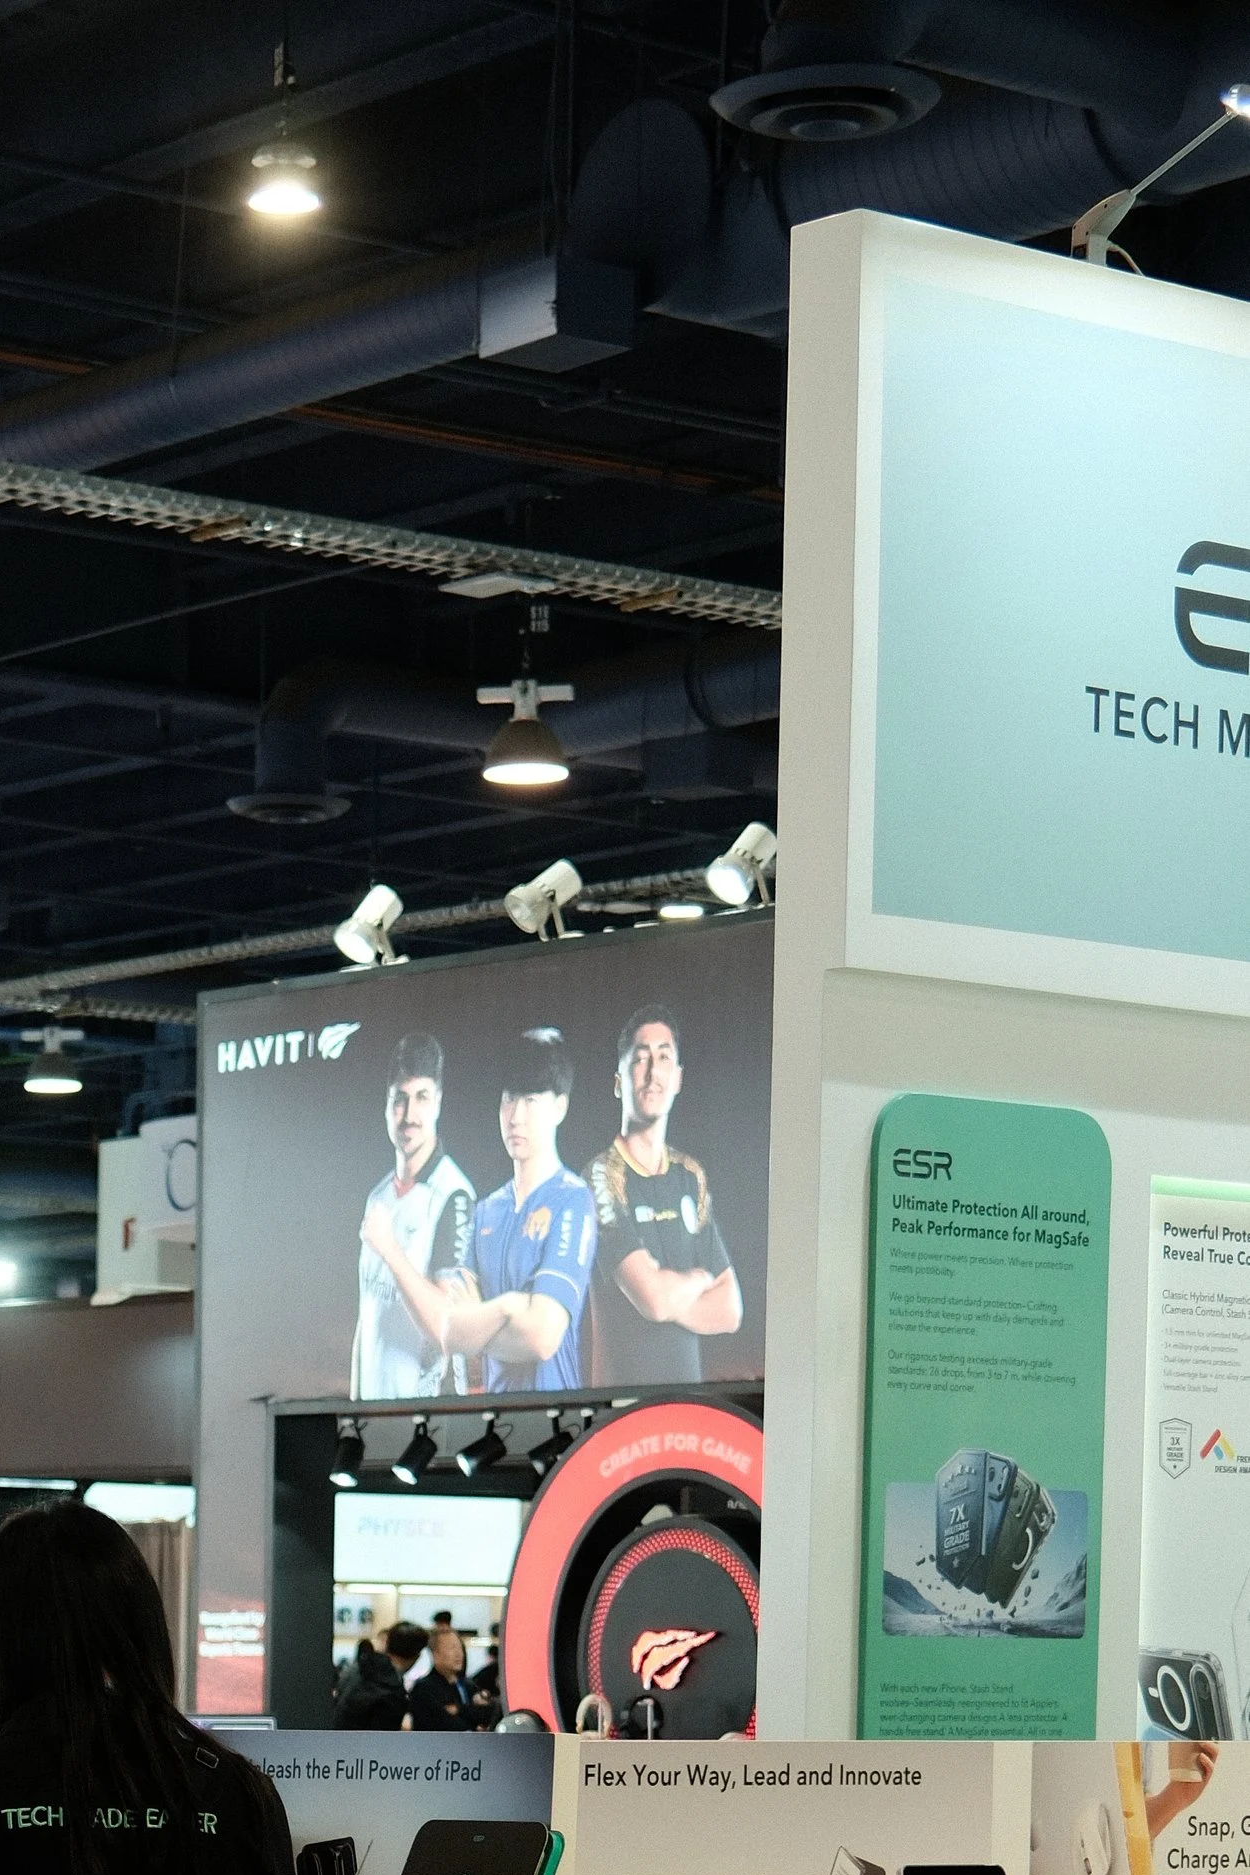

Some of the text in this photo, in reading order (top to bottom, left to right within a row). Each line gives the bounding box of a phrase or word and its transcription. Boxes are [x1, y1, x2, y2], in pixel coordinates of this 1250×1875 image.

[1085, 685, 1199, 750] TECH
[217, 1030, 305, 1074] HAVIT
[892, 1148, 953, 1180] ESR
[892, 1194, 1090, 1226] Ultimate Protection All around,
[892, 1217, 1090, 1249] Peak Performance for MagSafe
[1163, 1222, 1218, 1240] Powerful
[890, 1248, 916, 1259] Where
[918, 1251, 943, 1263] power
[944, 1254, 968, 1264] meets
[1008, 1256, 1033, 1268] Where
[1035, 1259, 1074, 1271] protection
[1163, 1245, 1204, 1262] Reveal
[1207, 1248, 1234, 1264] True
[890, 1264, 913, 1274] meets
[917, 1293, 946, 1306] beyond
[949, 1296, 982, 1307] standard
[1162, 1289, 1188, 1301] Classic
[1190, 1291, 1215, 1304] Hybrid
[889, 1308, 1064, 1327] solutions that keep up with daily demands and
[1161, 1303, 1193, 1315] (Camera
[1195, 1306, 1224, 1319] Control,
[1226, 1308, 1246, 1319] Stash
[888, 1322, 916, 1332] elevate
[918, 1322, 932, 1333] the
[887, 1349, 903, 1361] Our
[905, 1351, 938, 1364] rigorous
[939, 1353, 965, 1366] testing
[967, 1356, 998, 1366] exceeds
[887, 1380, 907, 1392] every
[909, 1381, 931, 1391] curve
[933, 1381, 948, 1392] and
[929, 1366, 940, 1377] 26
[967, 1367, 985, 1379] from
[993, 1371, 1002, 1381] to
[1021, 1371, 1042, 1382] while
[1043, 1374, 1076, 1387] covering
[599, 1431, 753, 1478] CREATE FOR GAME
[950, 1504, 966, 1524] 7X
[943, 1530, 970, 1548] GRADE
[880, 1683, 1014, 1694] With each new Stash Stand
[1011, 1699, 1019, 1708] to
[937, 1714, 966, 1723] camera
[1008, 1713, 1022, 1722] lens
[1062, 1713, 1068, 1721] A
[955, 1727, 989, 1739] MagSafe
[1027, 1726, 1038, 1736] All
[1039, 1727, 1046, 1736] in
[1048, 1729, 1063, 1737] one
[306, 1759, 330, 1780] the
[336, 1759, 364, 1780] Full
[369, 1760, 420, 1781] Power
[424, 1759, 442, 1781] of
[445, 1760, 482, 1782] iPad
[584, 1764, 922, 1793] Flex Your Way, Lead and Innovate
[1, 1806, 64, 1830] TECH
[1188, 1815, 1235, 1842] Snap,
[1167, 1848, 1230, 1875] Charge
